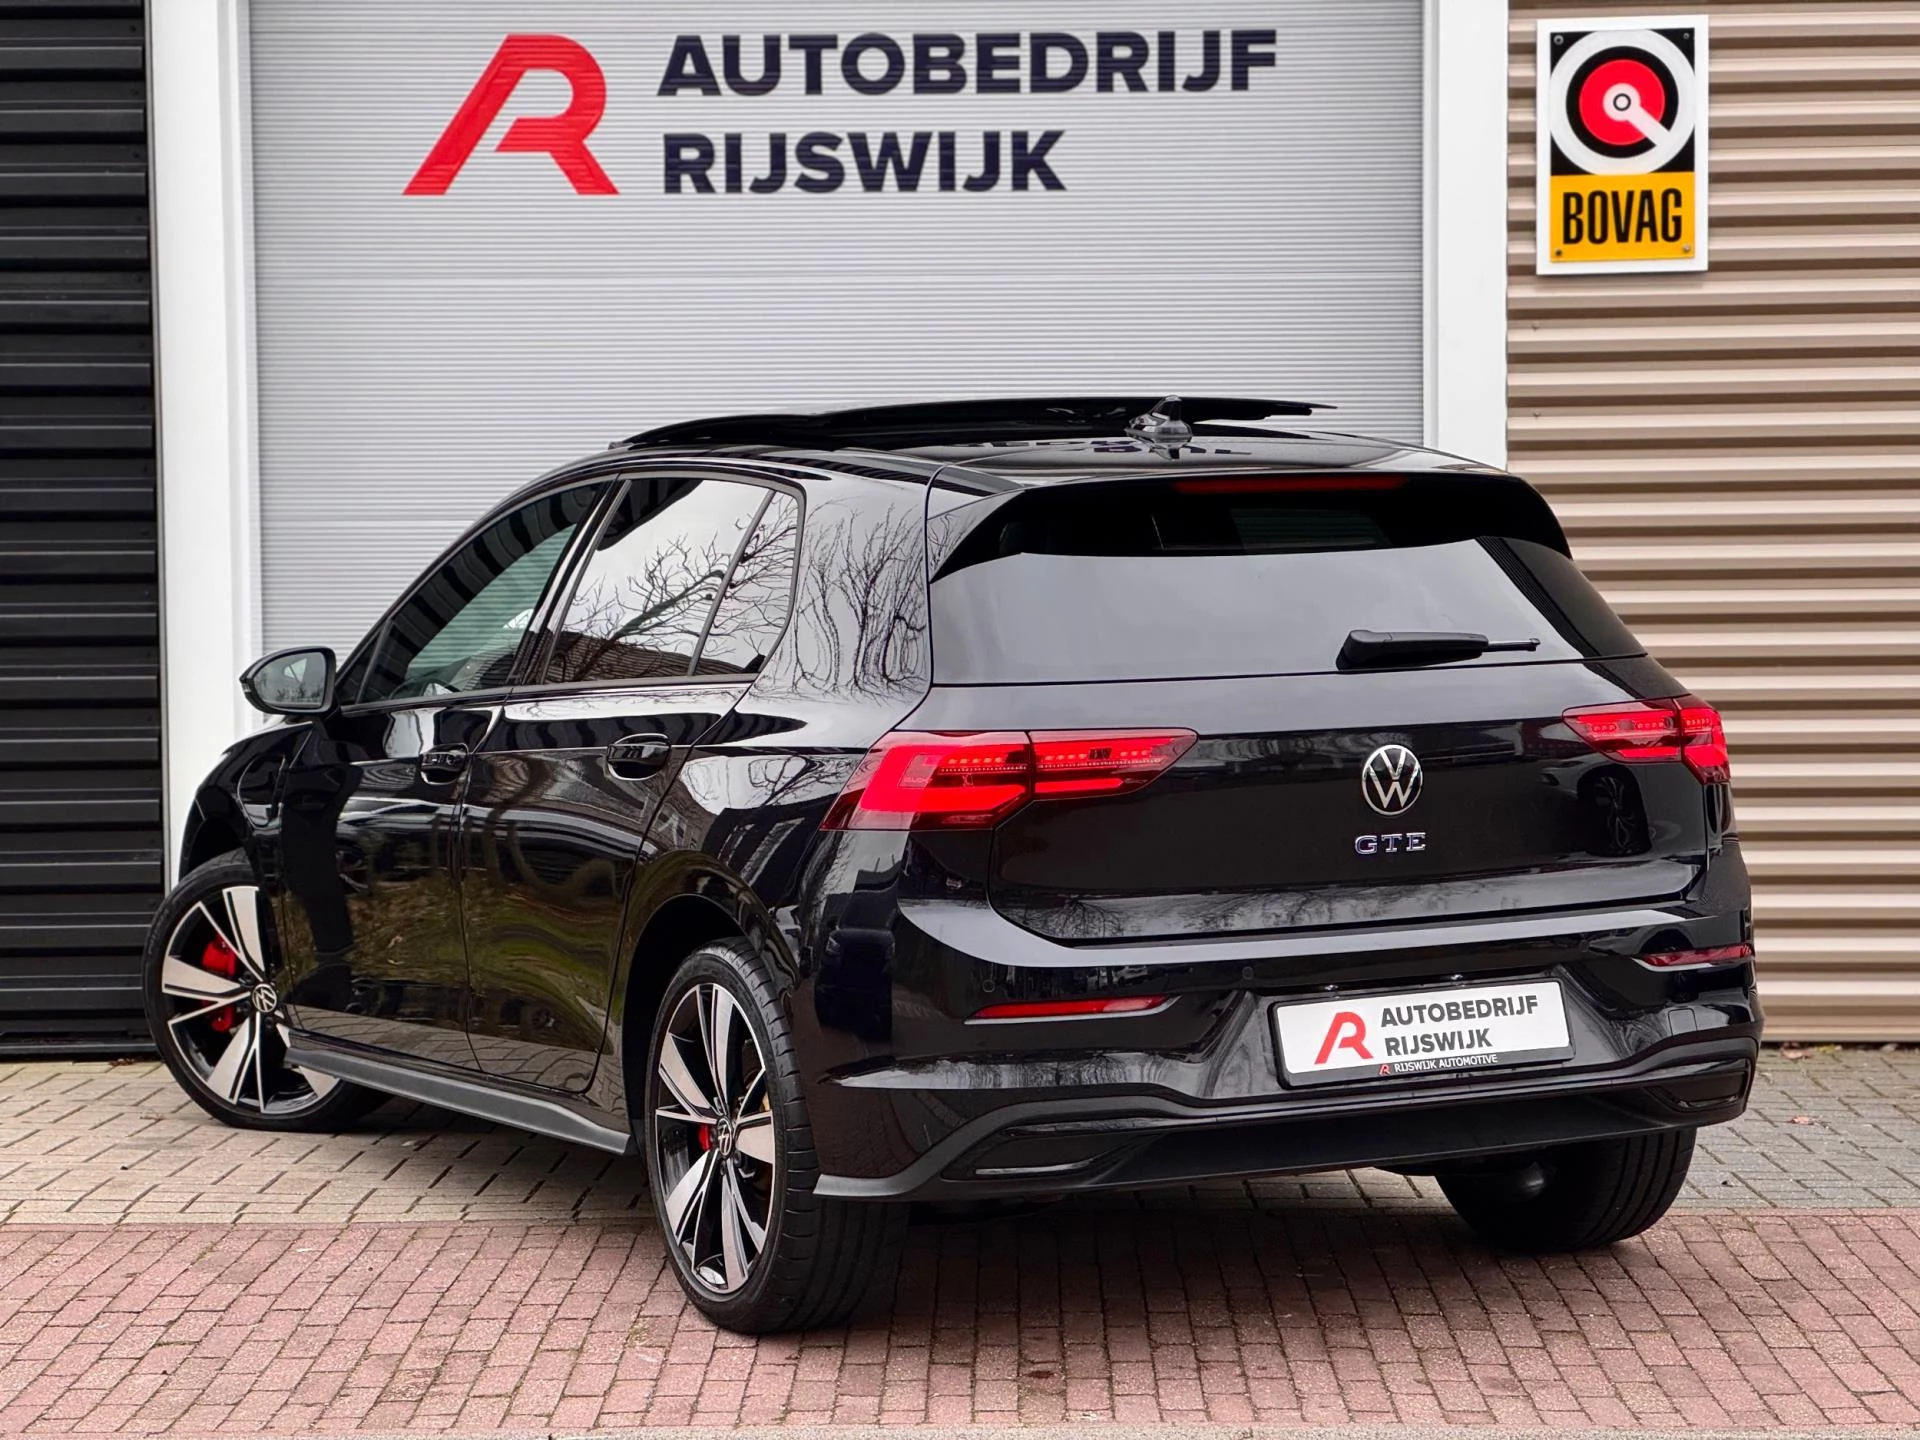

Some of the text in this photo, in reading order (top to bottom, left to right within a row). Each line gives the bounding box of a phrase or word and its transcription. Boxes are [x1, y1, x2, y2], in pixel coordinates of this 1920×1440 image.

[656, 29, 1277, 97] AUTOBEDRIJF
[662, 130, 1067, 195] RIJSWIJK
[1562, 187, 1683, 245] BOVAG
[1354, 832, 1426, 855] GTE
[1380, 995, 1538, 1028] AUTOBEDRIJF
[1384, 1028, 1493, 1057] RIJSWIJK
[1394, 1060, 1437, 1073] RIJSWIJK
[1438, 1053, 1499, 1069] AUTOMOTIVE
